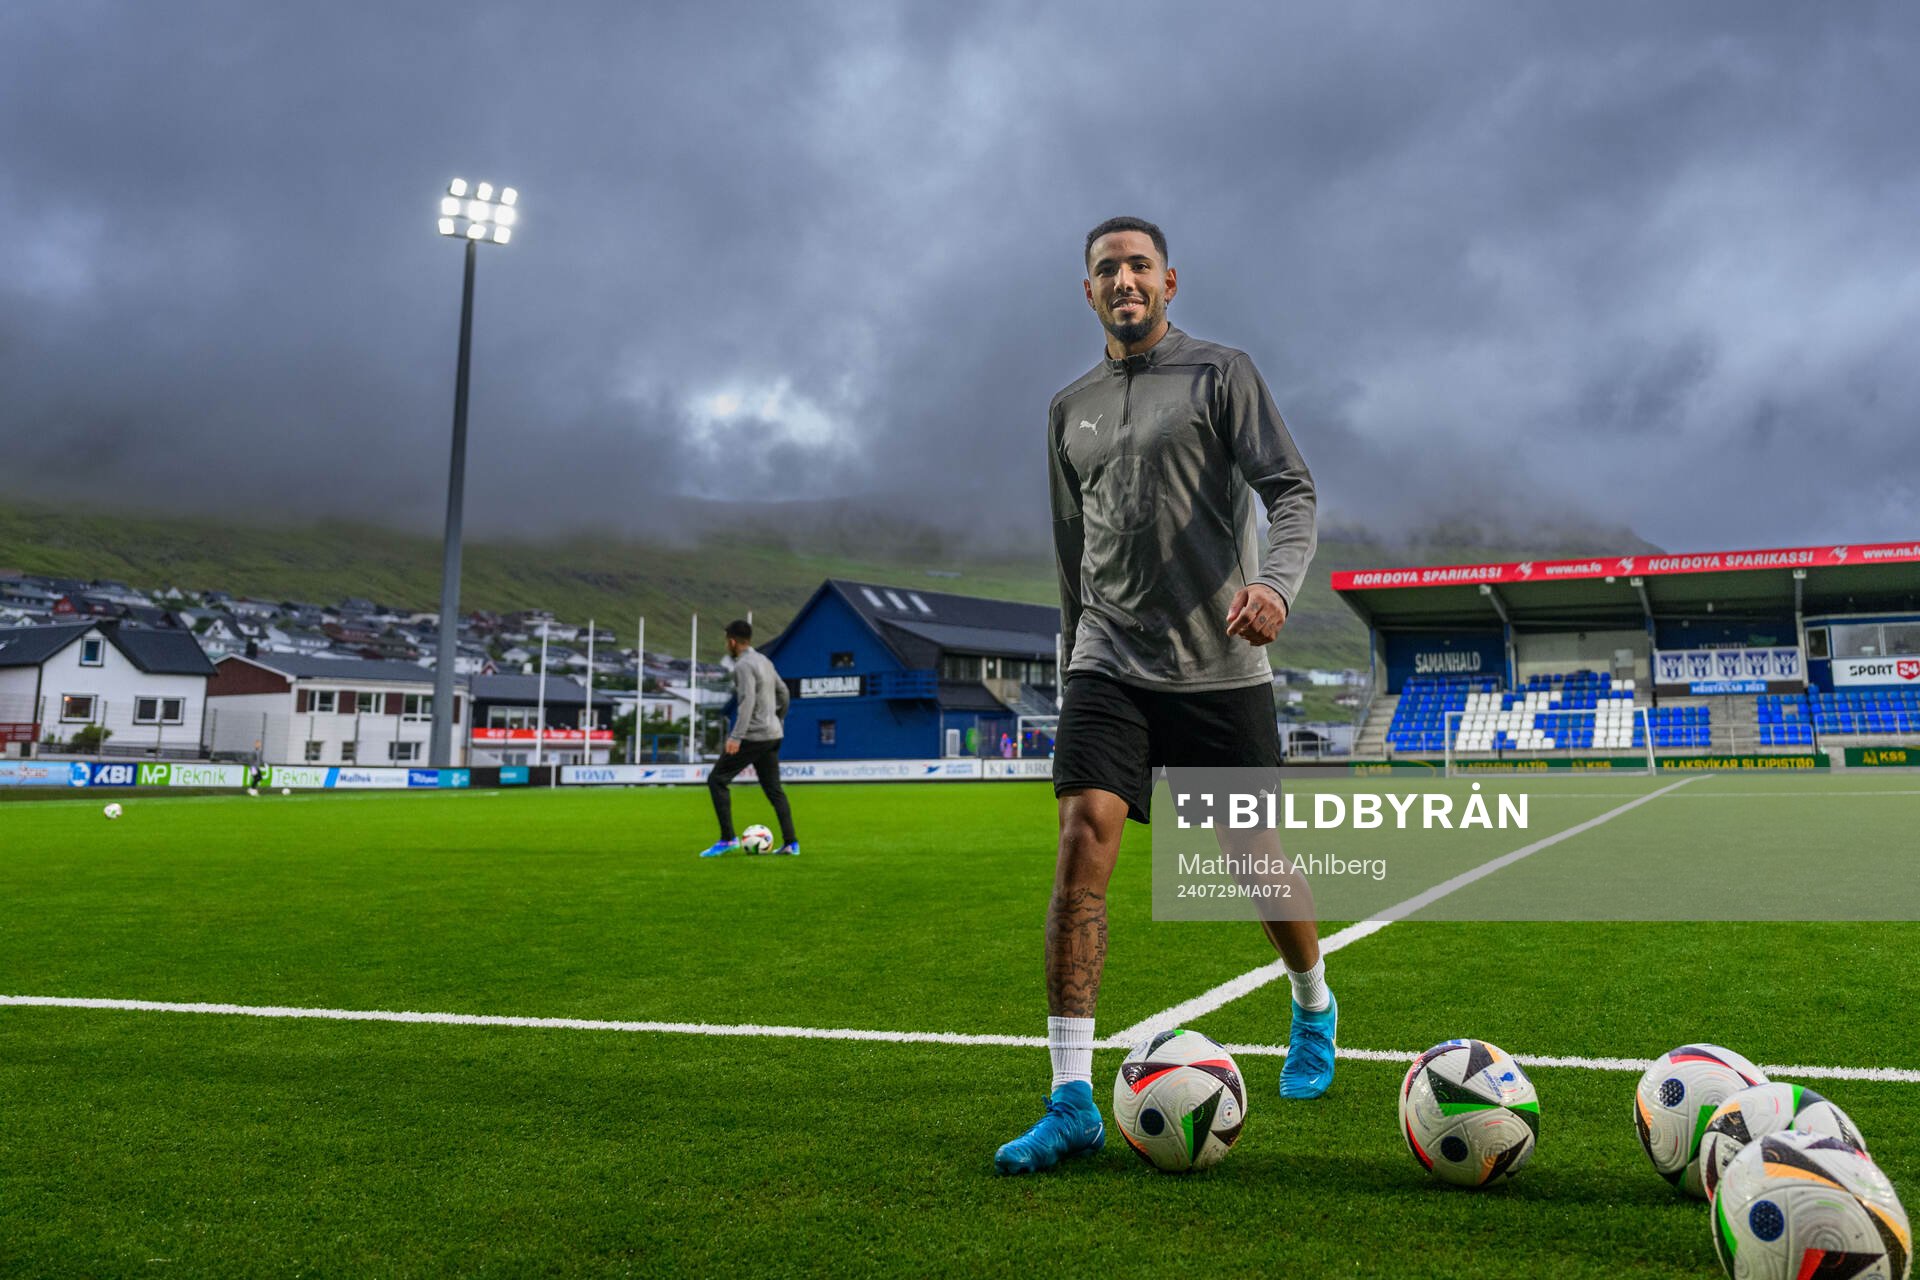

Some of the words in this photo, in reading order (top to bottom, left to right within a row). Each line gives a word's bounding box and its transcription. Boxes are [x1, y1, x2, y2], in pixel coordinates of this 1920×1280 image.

[1725, 551, 1814, 567] SPARIKASSI
[1422, 567, 1502, 583] SPARIKASSI
[1545, 563, 1602, 575] www.ns.fo
[1415, 652, 1481, 674] SAMANHALD
[1849, 664, 1894, 677] SPORT
[1898, 661, 1920, 676] 24
[94, 765, 133, 784] KBI
[141, 765, 168, 784] MP
[176, 766, 226, 785] Teknik
[276, 768, 321, 786] Teknik
